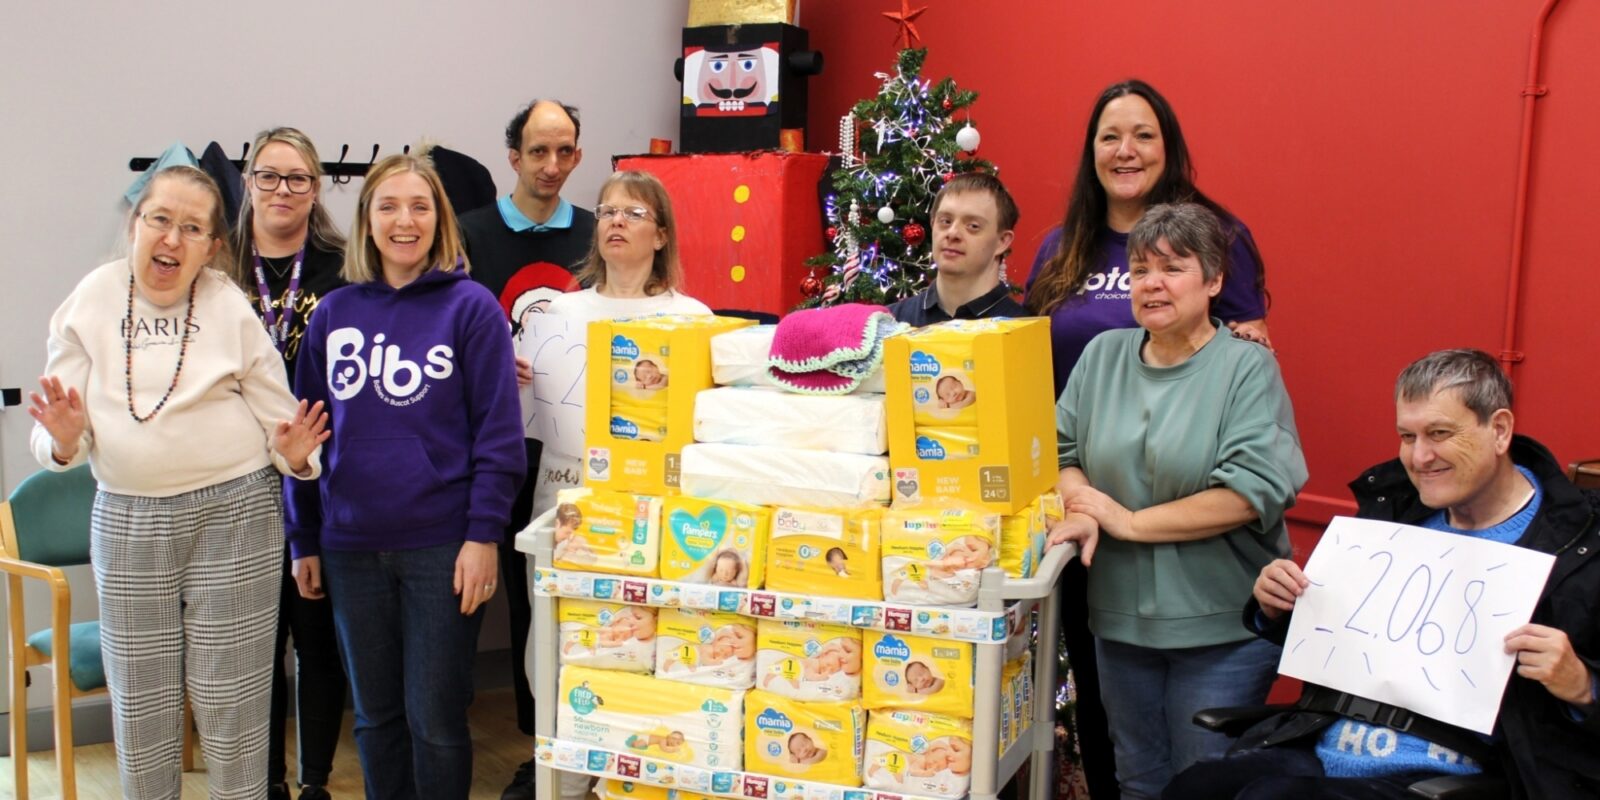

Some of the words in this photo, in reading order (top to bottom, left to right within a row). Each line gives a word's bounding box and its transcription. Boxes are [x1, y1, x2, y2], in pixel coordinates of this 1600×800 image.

[121, 316, 200, 338] PARIS
[326, 327, 454, 401] Bibs
[409, 383, 431, 403] Support
[916, 443, 943, 457] amia
[668, 457, 675, 469] 1
[666, 474, 678, 483] 24
[983, 471, 991, 481] 1
[983, 490, 996, 498] 24
[682, 522, 718, 539] Pampers
[1345, 551, 1485, 655] 2.068
[876, 642, 908, 656] mamia
[787, 660, 793, 671] 1
[574, 723, 609, 733] newborn
[758, 715, 790, 728] mamia
[1337, 721, 1398, 758] HO
[893, 753, 898, 765] 1
